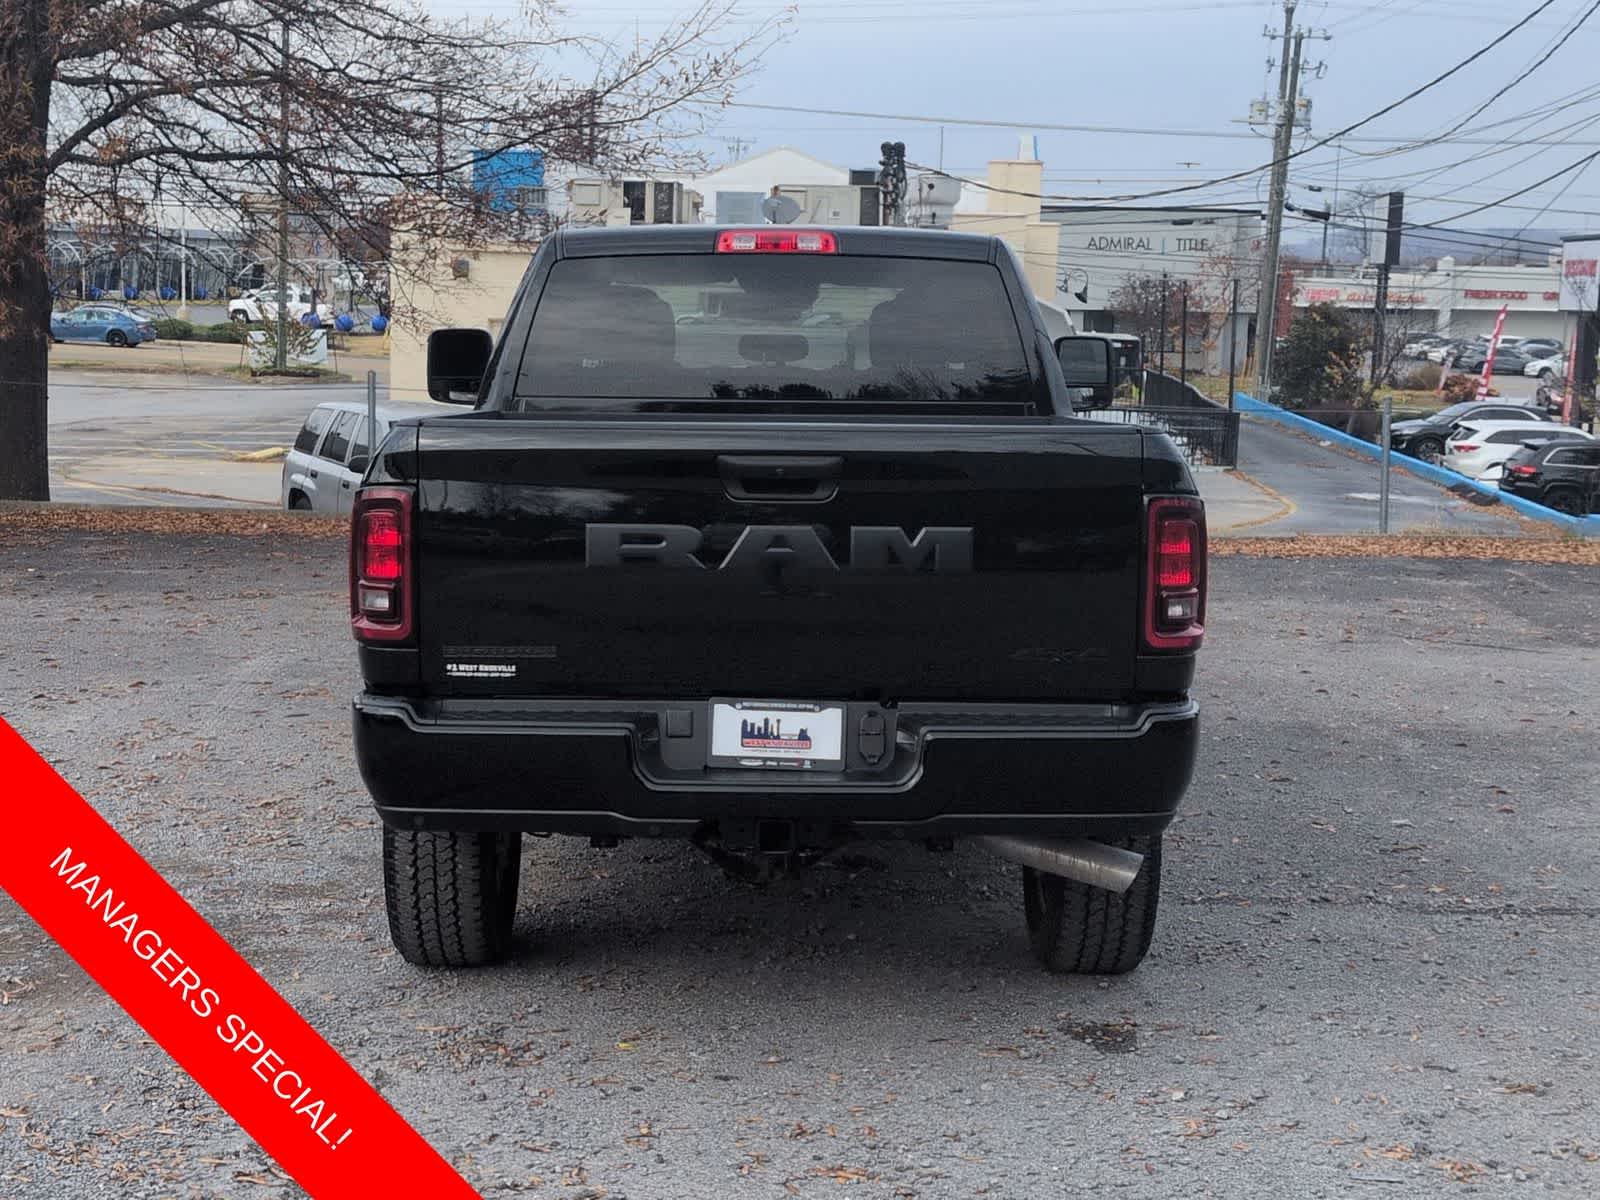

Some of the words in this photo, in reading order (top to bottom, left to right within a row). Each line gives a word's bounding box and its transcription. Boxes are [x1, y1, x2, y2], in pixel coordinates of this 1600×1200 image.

[1087, 236, 1152, 250] ADMIRAL
[1175, 238, 1209, 251] TITLE
[585, 523, 974, 570] RAM
